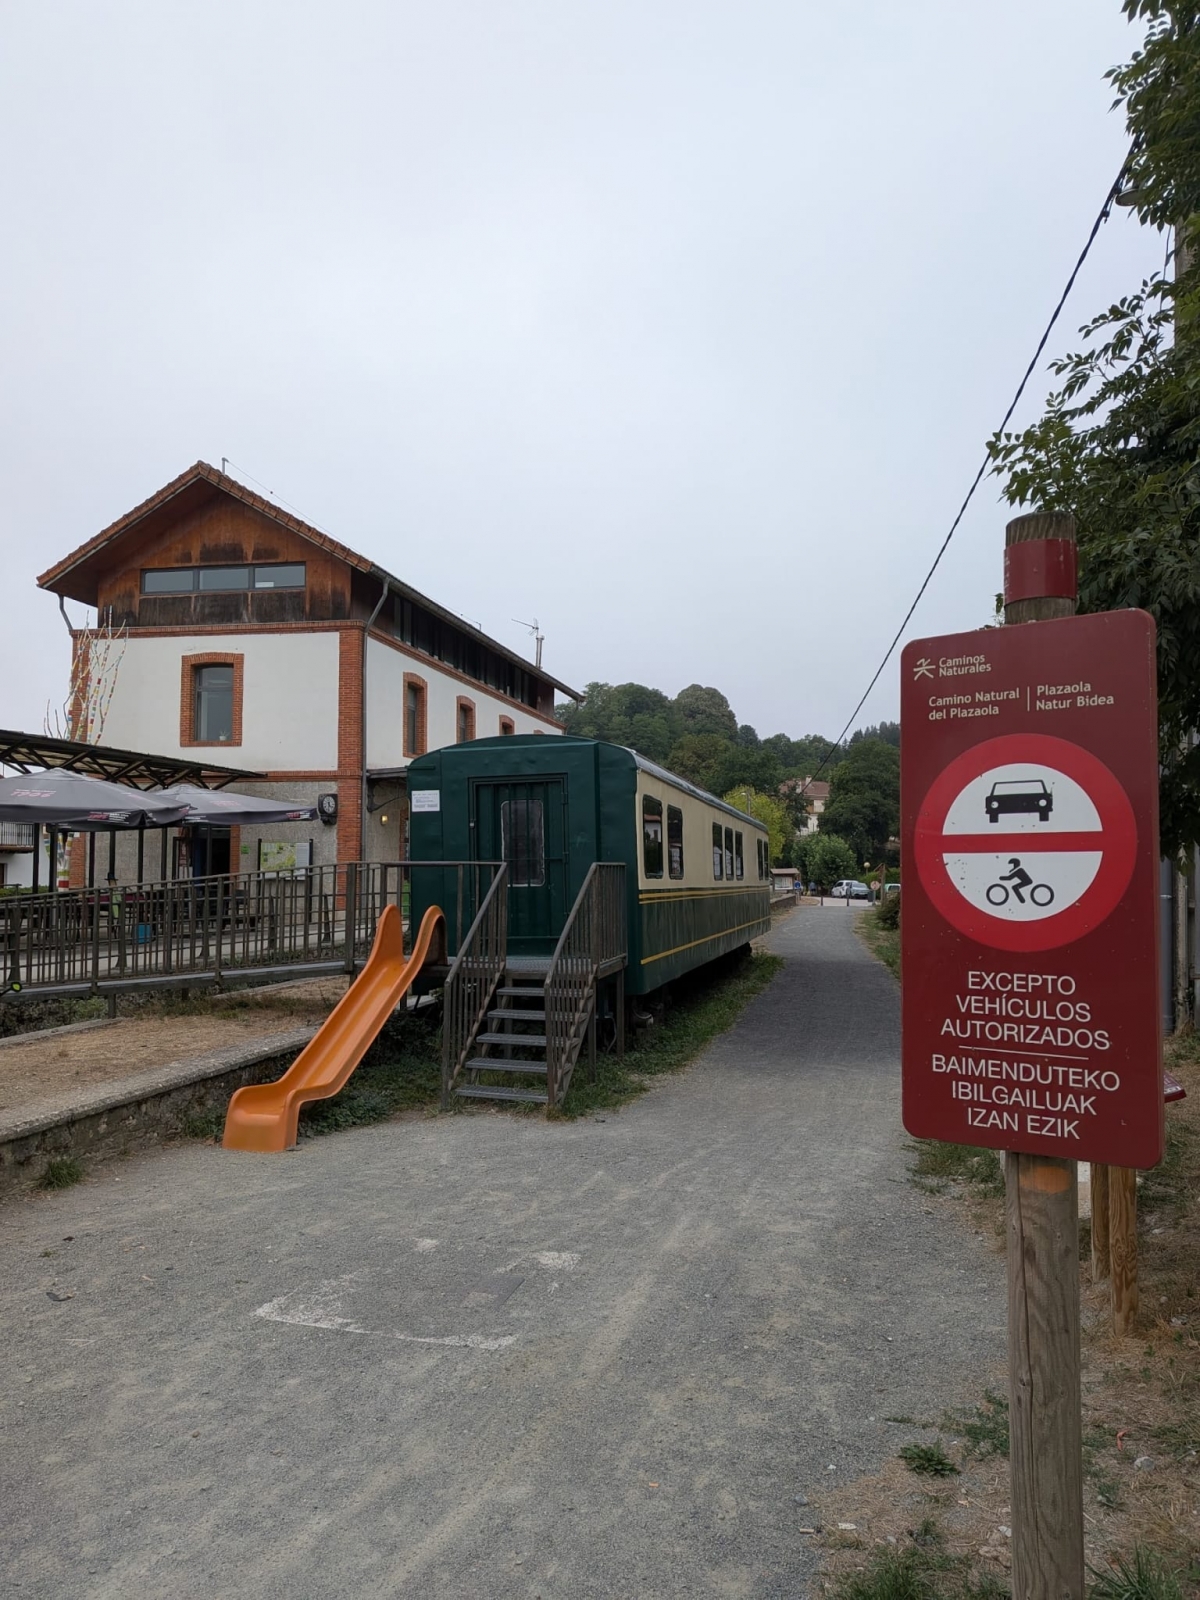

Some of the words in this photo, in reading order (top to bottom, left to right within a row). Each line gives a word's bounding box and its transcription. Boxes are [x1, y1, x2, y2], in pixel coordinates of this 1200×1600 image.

[939, 654, 985, 667] Caminos
[939, 663, 992, 677] Naturales
[928, 693, 972, 707] Camino
[975, 687, 1020, 703] Natural
[1036, 681, 1092, 697] Plazaola
[928, 708, 947, 721] del
[950, 704, 1000, 719] Plazaola
[1036, 696, 1074, 711] Natur
[1076, 694, 1115, 708] Bidea
[967, 971, 1077, 996] EXCEPTO
[955, 993, 1092, 1023] VEHÍCULOS
[940, 1018, 1111, 1050] AUTORIZADOS
[932, 1054, 1121, 1092] BAIMENDUTEKO
[952, 1080, 1097, 1116] IBILGAILUAK
[967, 1106, 1019, 1132] IZAN
[1026, 1114, 1080, 1140] EZIK
